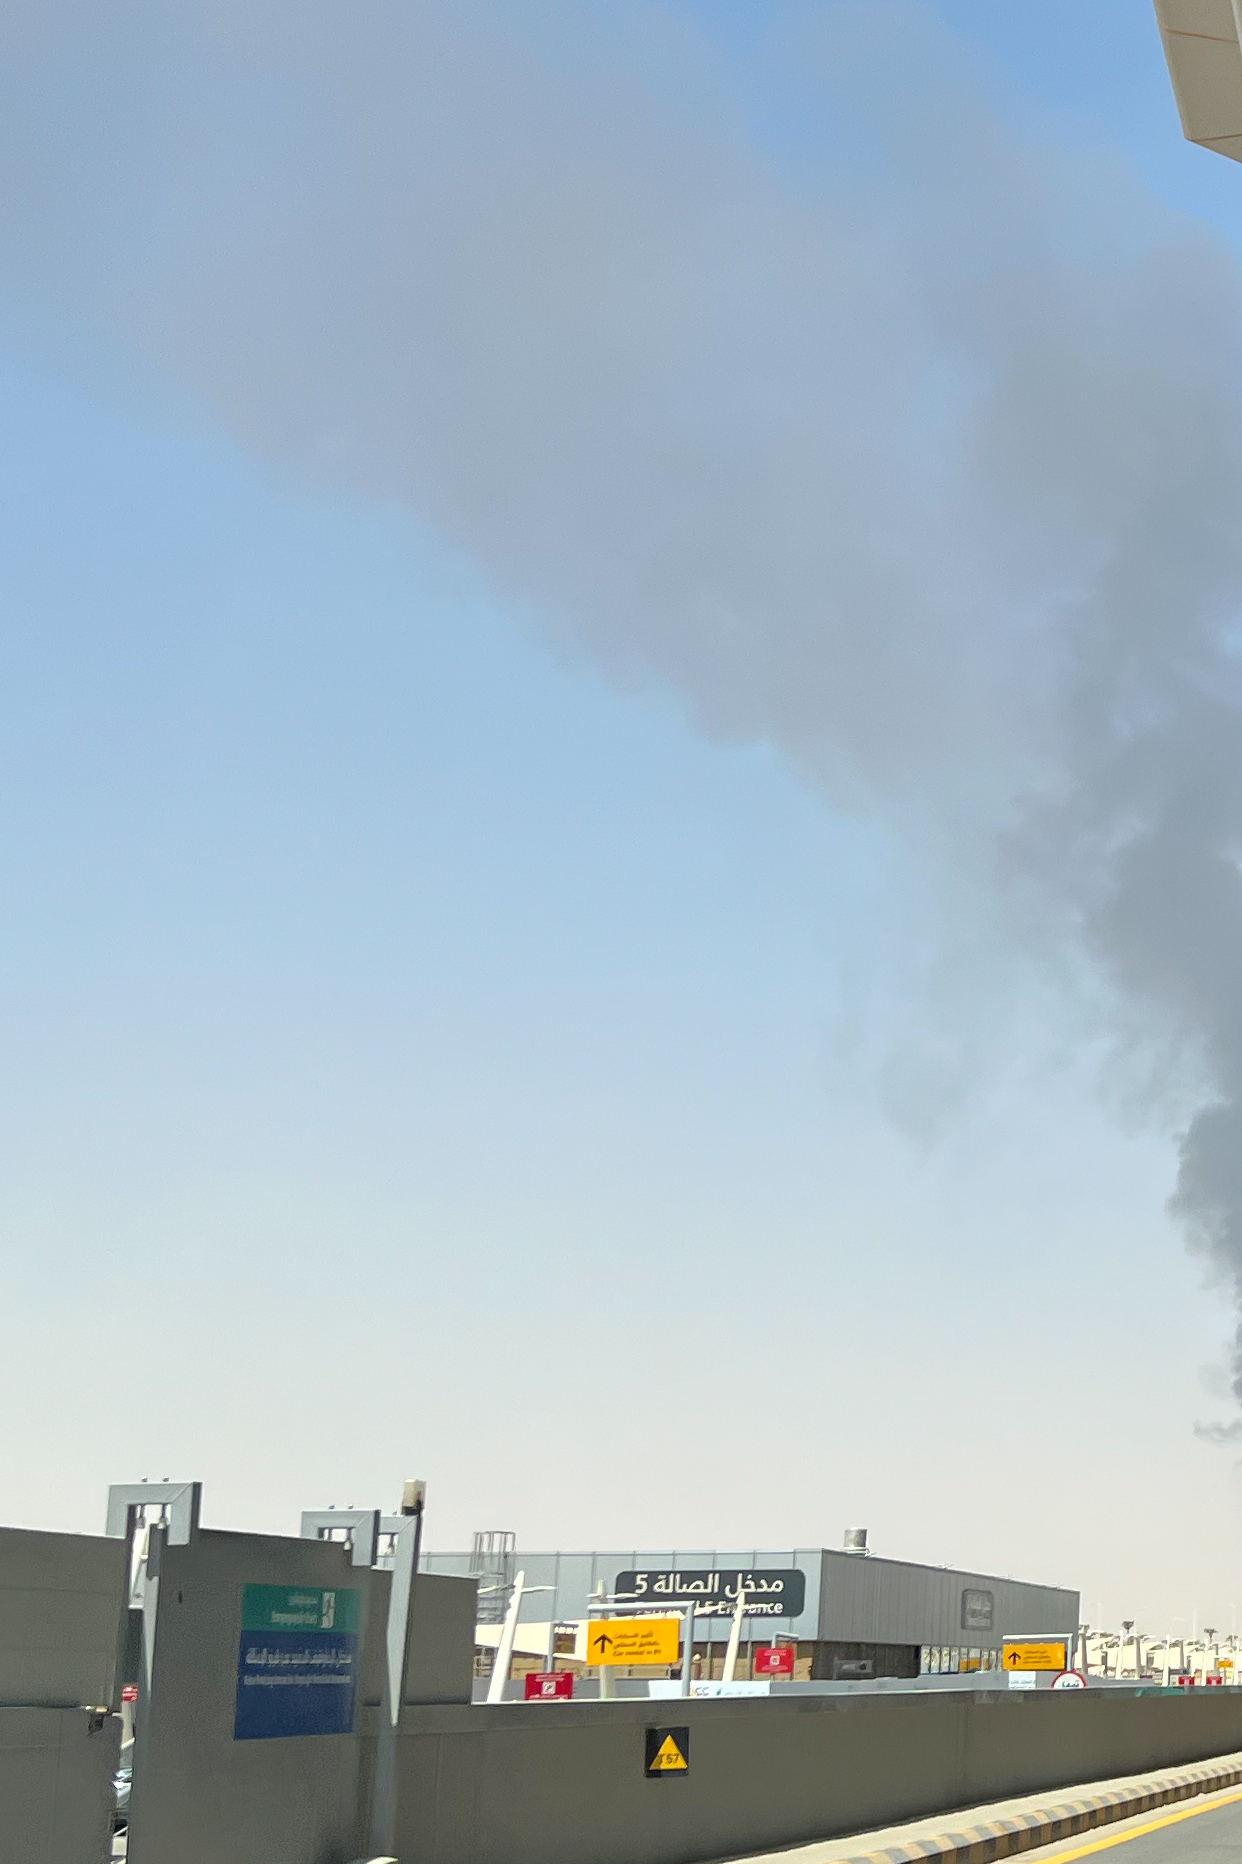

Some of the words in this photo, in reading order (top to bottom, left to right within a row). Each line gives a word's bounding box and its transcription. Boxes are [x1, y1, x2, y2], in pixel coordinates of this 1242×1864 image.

[635, 1573, 649, 1594] 5
[653, 1572, 720, 1594] الصالة
[724, 1572, 784, 1599] مدخل
